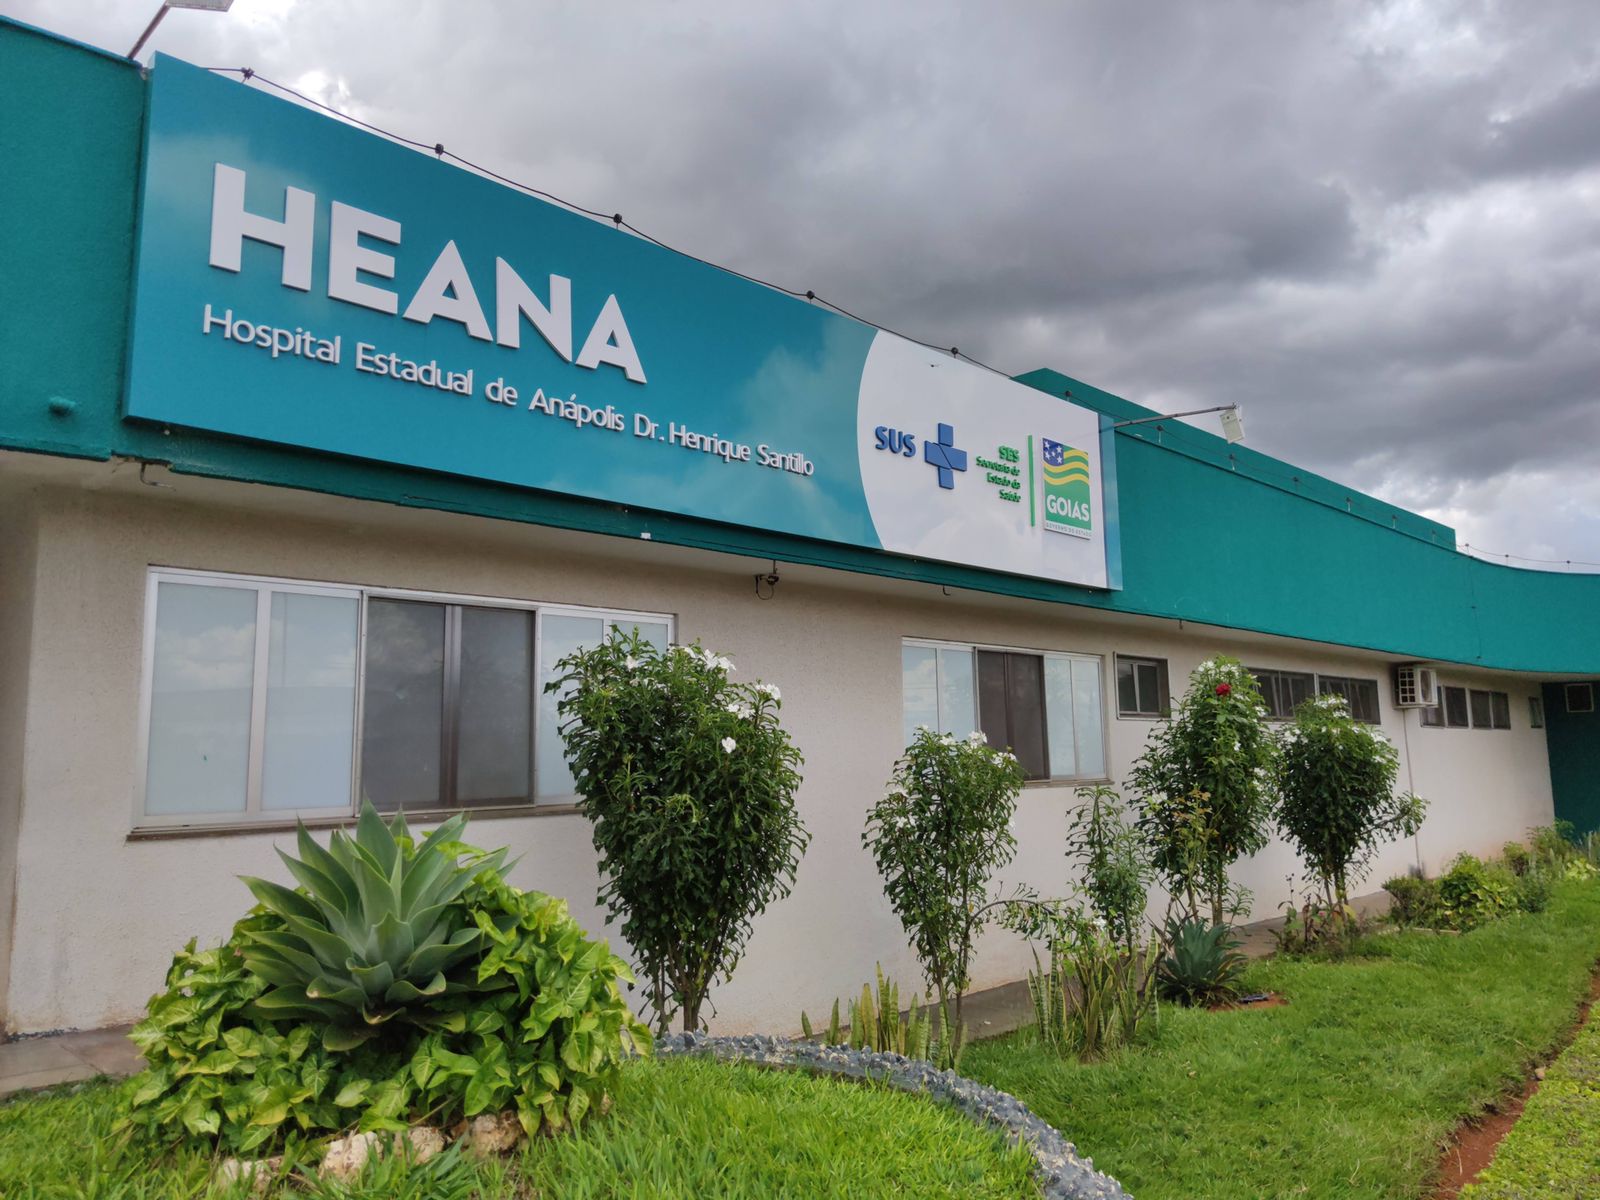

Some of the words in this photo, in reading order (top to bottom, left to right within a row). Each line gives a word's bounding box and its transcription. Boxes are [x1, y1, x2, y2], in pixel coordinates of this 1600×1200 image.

[209, 162, 647, 384] HEANA
[203, 304, 341, 364] Hospital
[355, 342, 473, 396] Estadual
[485, 377, 518, 407] de
[529, 387, 625, 432] Anápolis
[633, 413, 665, 441] Dr.
[669, 422, 750, 463] Henrique
[756, 444, 814, 476] Santillo
[875, 426, 916, 457] SUS
[976, 455, 1010, 473] Secretaria
[999, 445, 1020, 463] SES
[987, 471, 1011, 487] Estado
